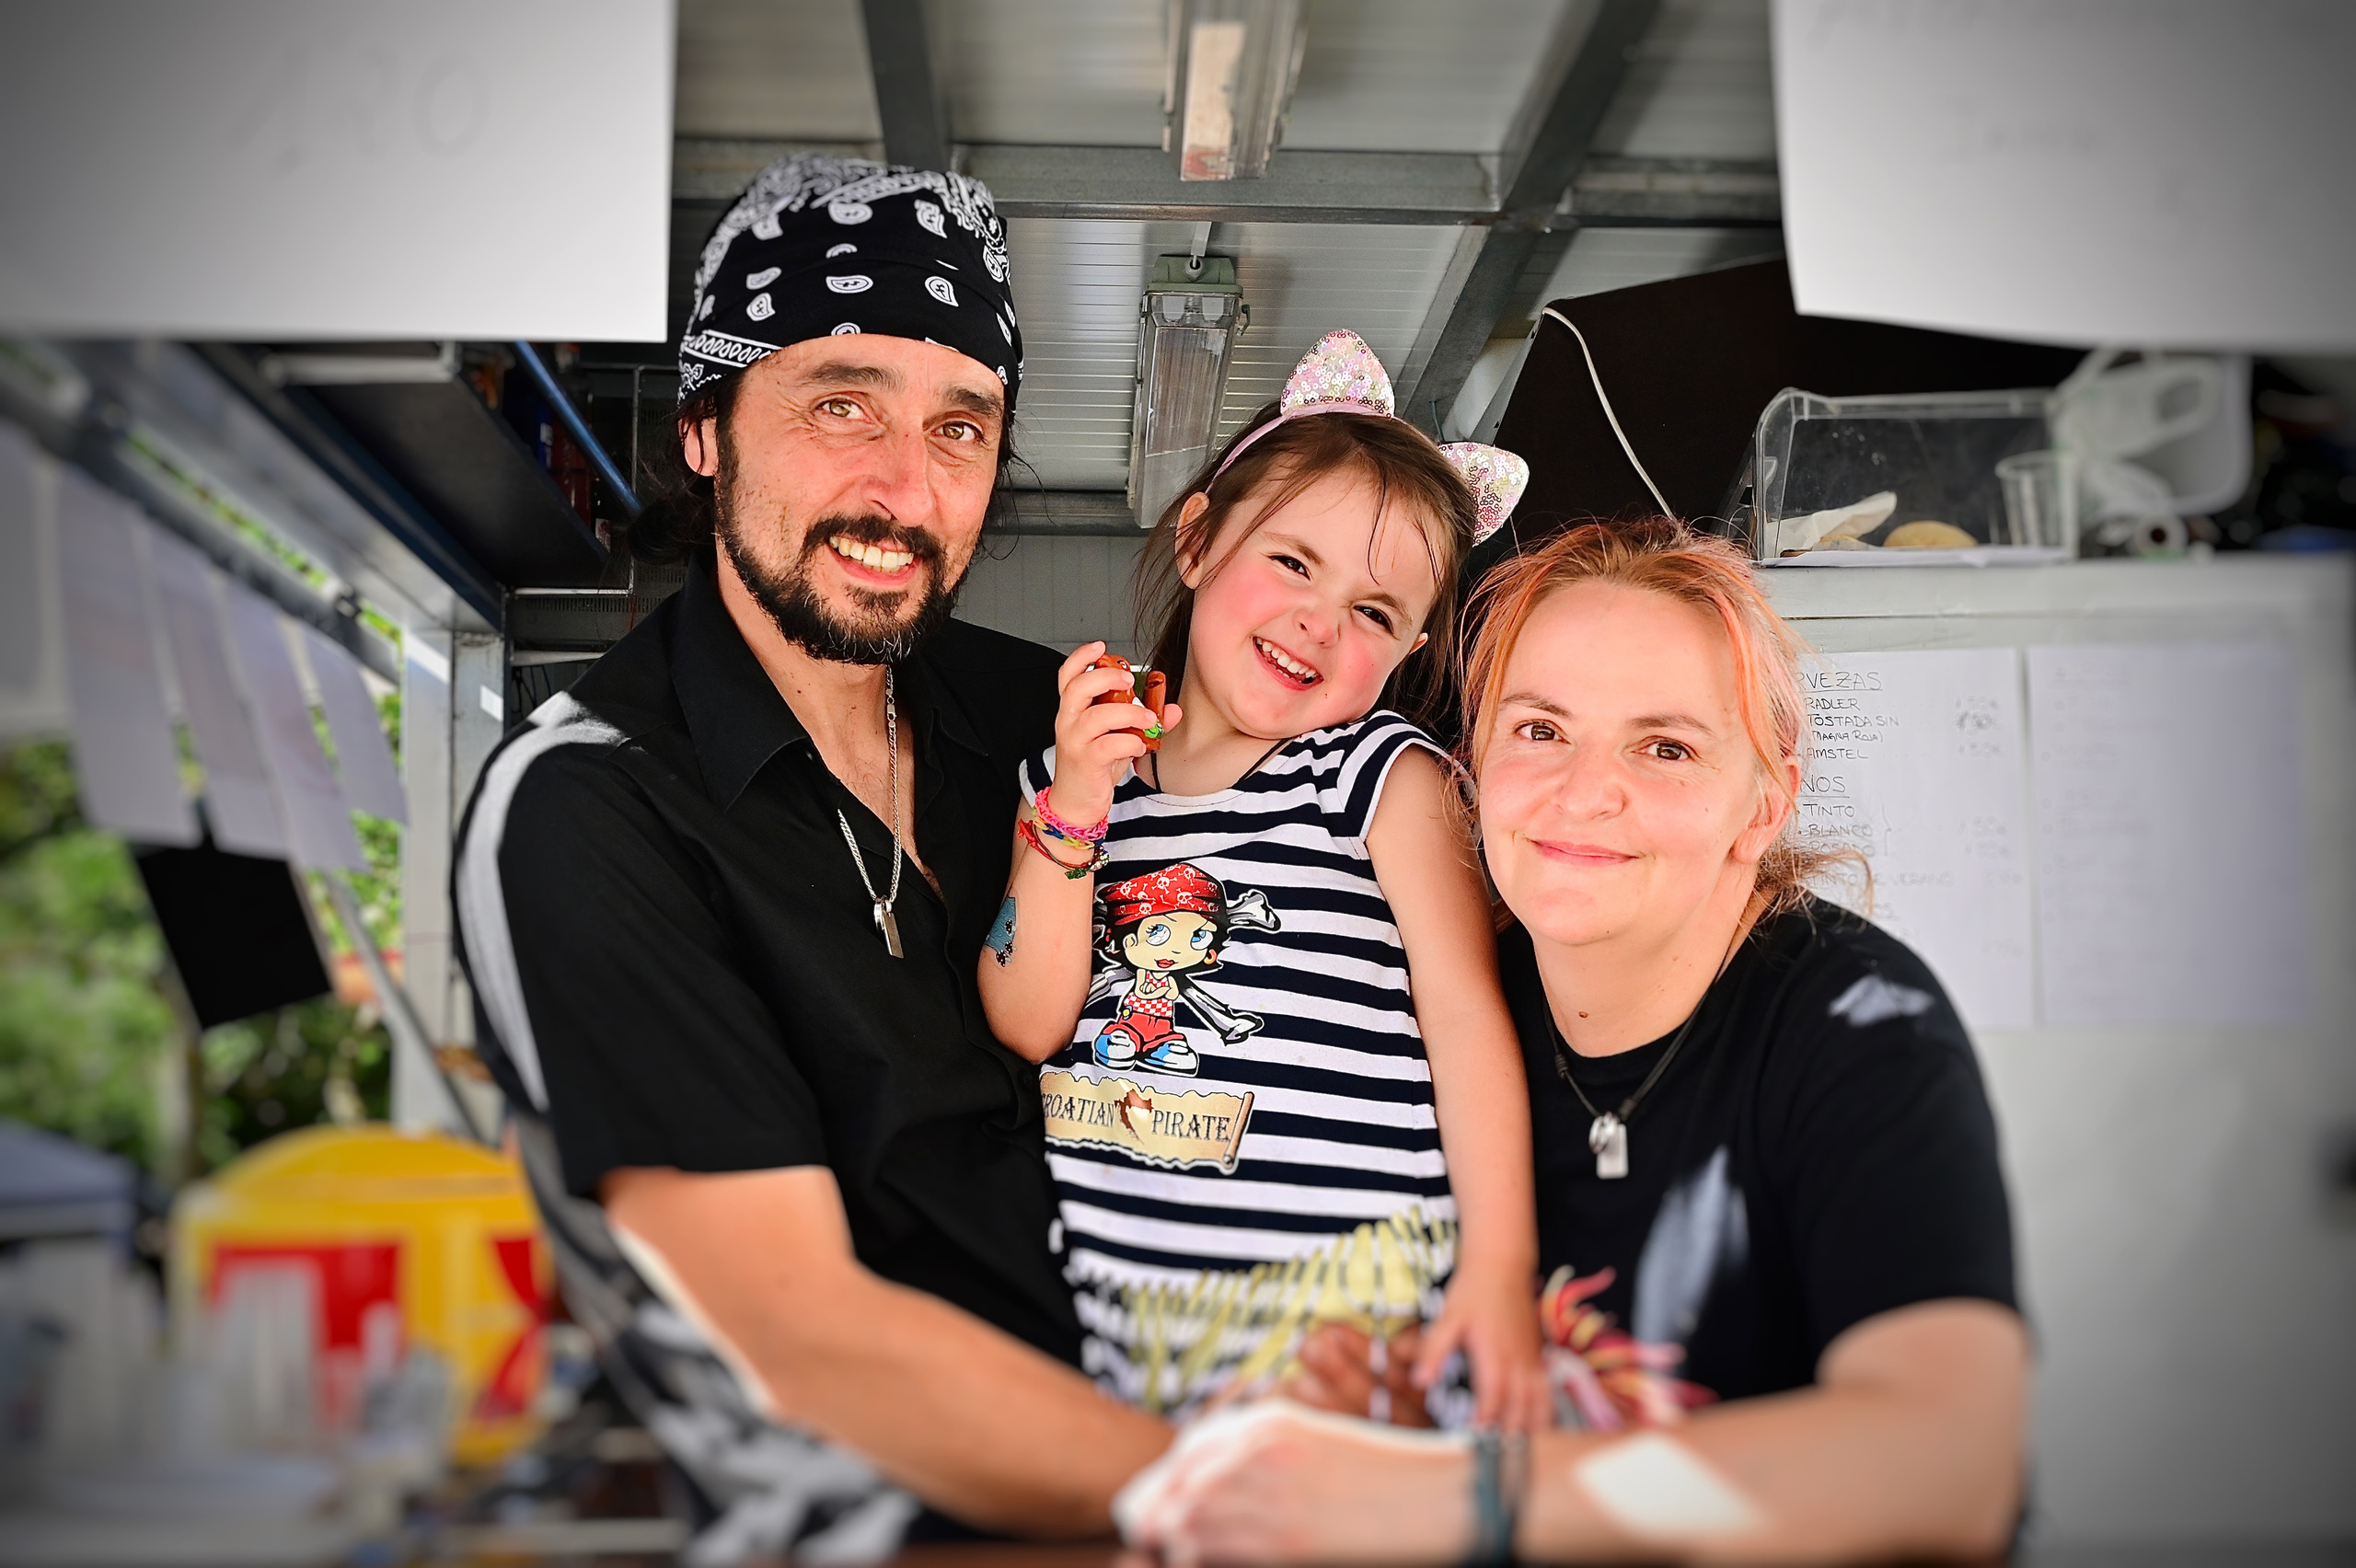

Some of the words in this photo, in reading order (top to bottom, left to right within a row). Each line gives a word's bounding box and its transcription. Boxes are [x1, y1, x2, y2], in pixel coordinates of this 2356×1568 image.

[1796, 671, 1882, 691] RVEZAS
[1804, 697, 1861, 711] RADLER
[1807, 713, 1873, 728] TOSTADA
[1876, 715, 1900, 727] SIN
[1806, 746, 1869, 760] AMSTEL
[1800, 774, 1846, 793] NOS
[1802, 802, 1855, 818] TINTO
[1807, 823, 1874, 837] BLANCO
[1151, 1109, 1231, 1143] PIRATE
